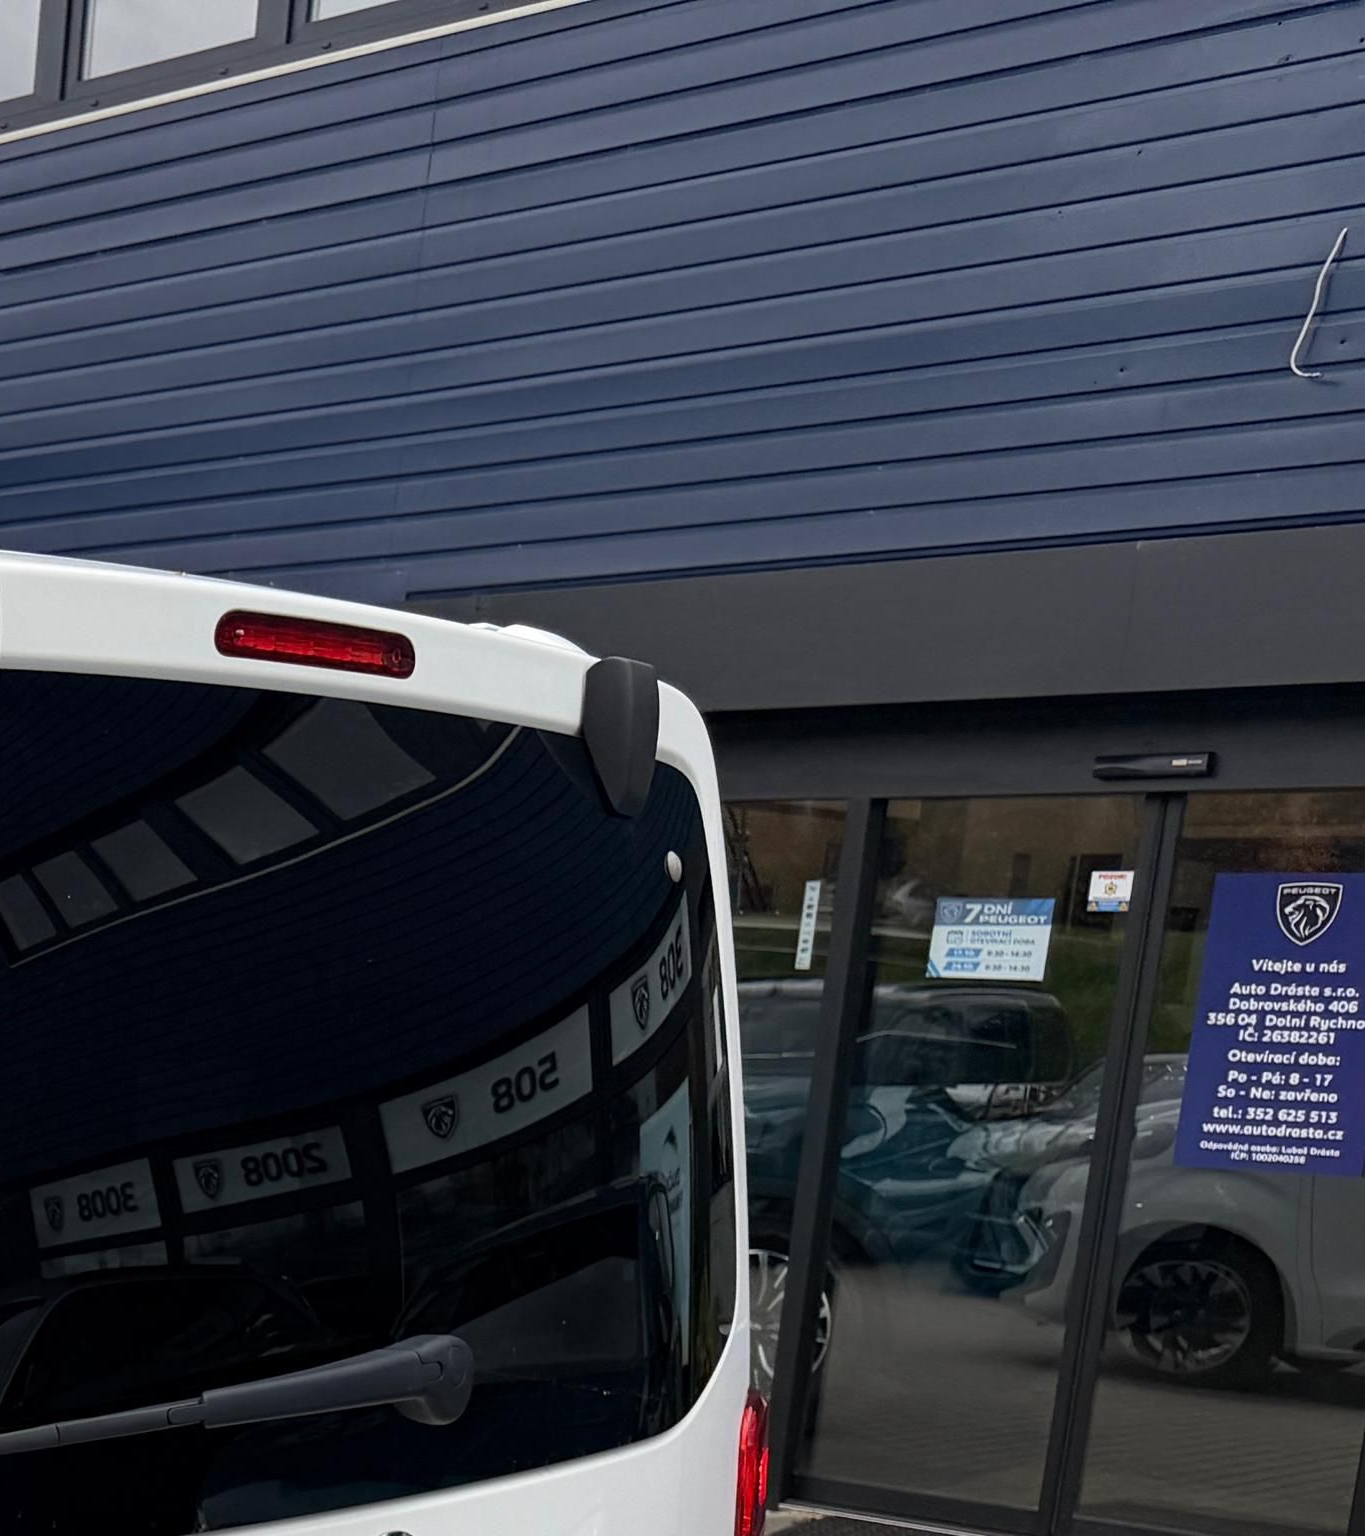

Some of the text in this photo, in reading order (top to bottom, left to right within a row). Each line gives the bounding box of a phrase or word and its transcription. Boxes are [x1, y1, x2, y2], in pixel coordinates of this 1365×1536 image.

[1283, 887, 1337, 895] PEUGEOT
[964, 903, 983, 924] 7
[983, 902, 1013, 915] DNÍ
[979, 915, 1047, 925] PEUGEOT
[1251, 959, 1346, 975] Vítejte u nás
[1229, 982, 1359, 998] Auto Drásta s.r.o.
[1229, 997, 1358, 1013] Dobrovského 406
[1207, 1012, 1235, 1025] 356
[1237, 1013, 1257, 1026] 04
[1265, 1014, 1306, 1028] Dolní
[1238, 1025, 1335, 1044] IČ: 26382261
[1227, 1049, 1341, 1066] Otevírací doba:
[1228, 1070, 1247, 1084] Po
[1261, 1071, 1286, 1085] Pá:
[1288, 1072, 1300, 1085] 8
[1315, 1074, 1333, 1087] 17
[1217, 1085, 1236, 1098] So
[1249, 1086, 1275, 1100] Ne:
[1278, 1088, 1338, 1103] zavřeno
[1213, 1105, 1338, 1124] tel.: 352 625 513
[1202, 1122, 1344, 1140] www.autodrasta.cz
